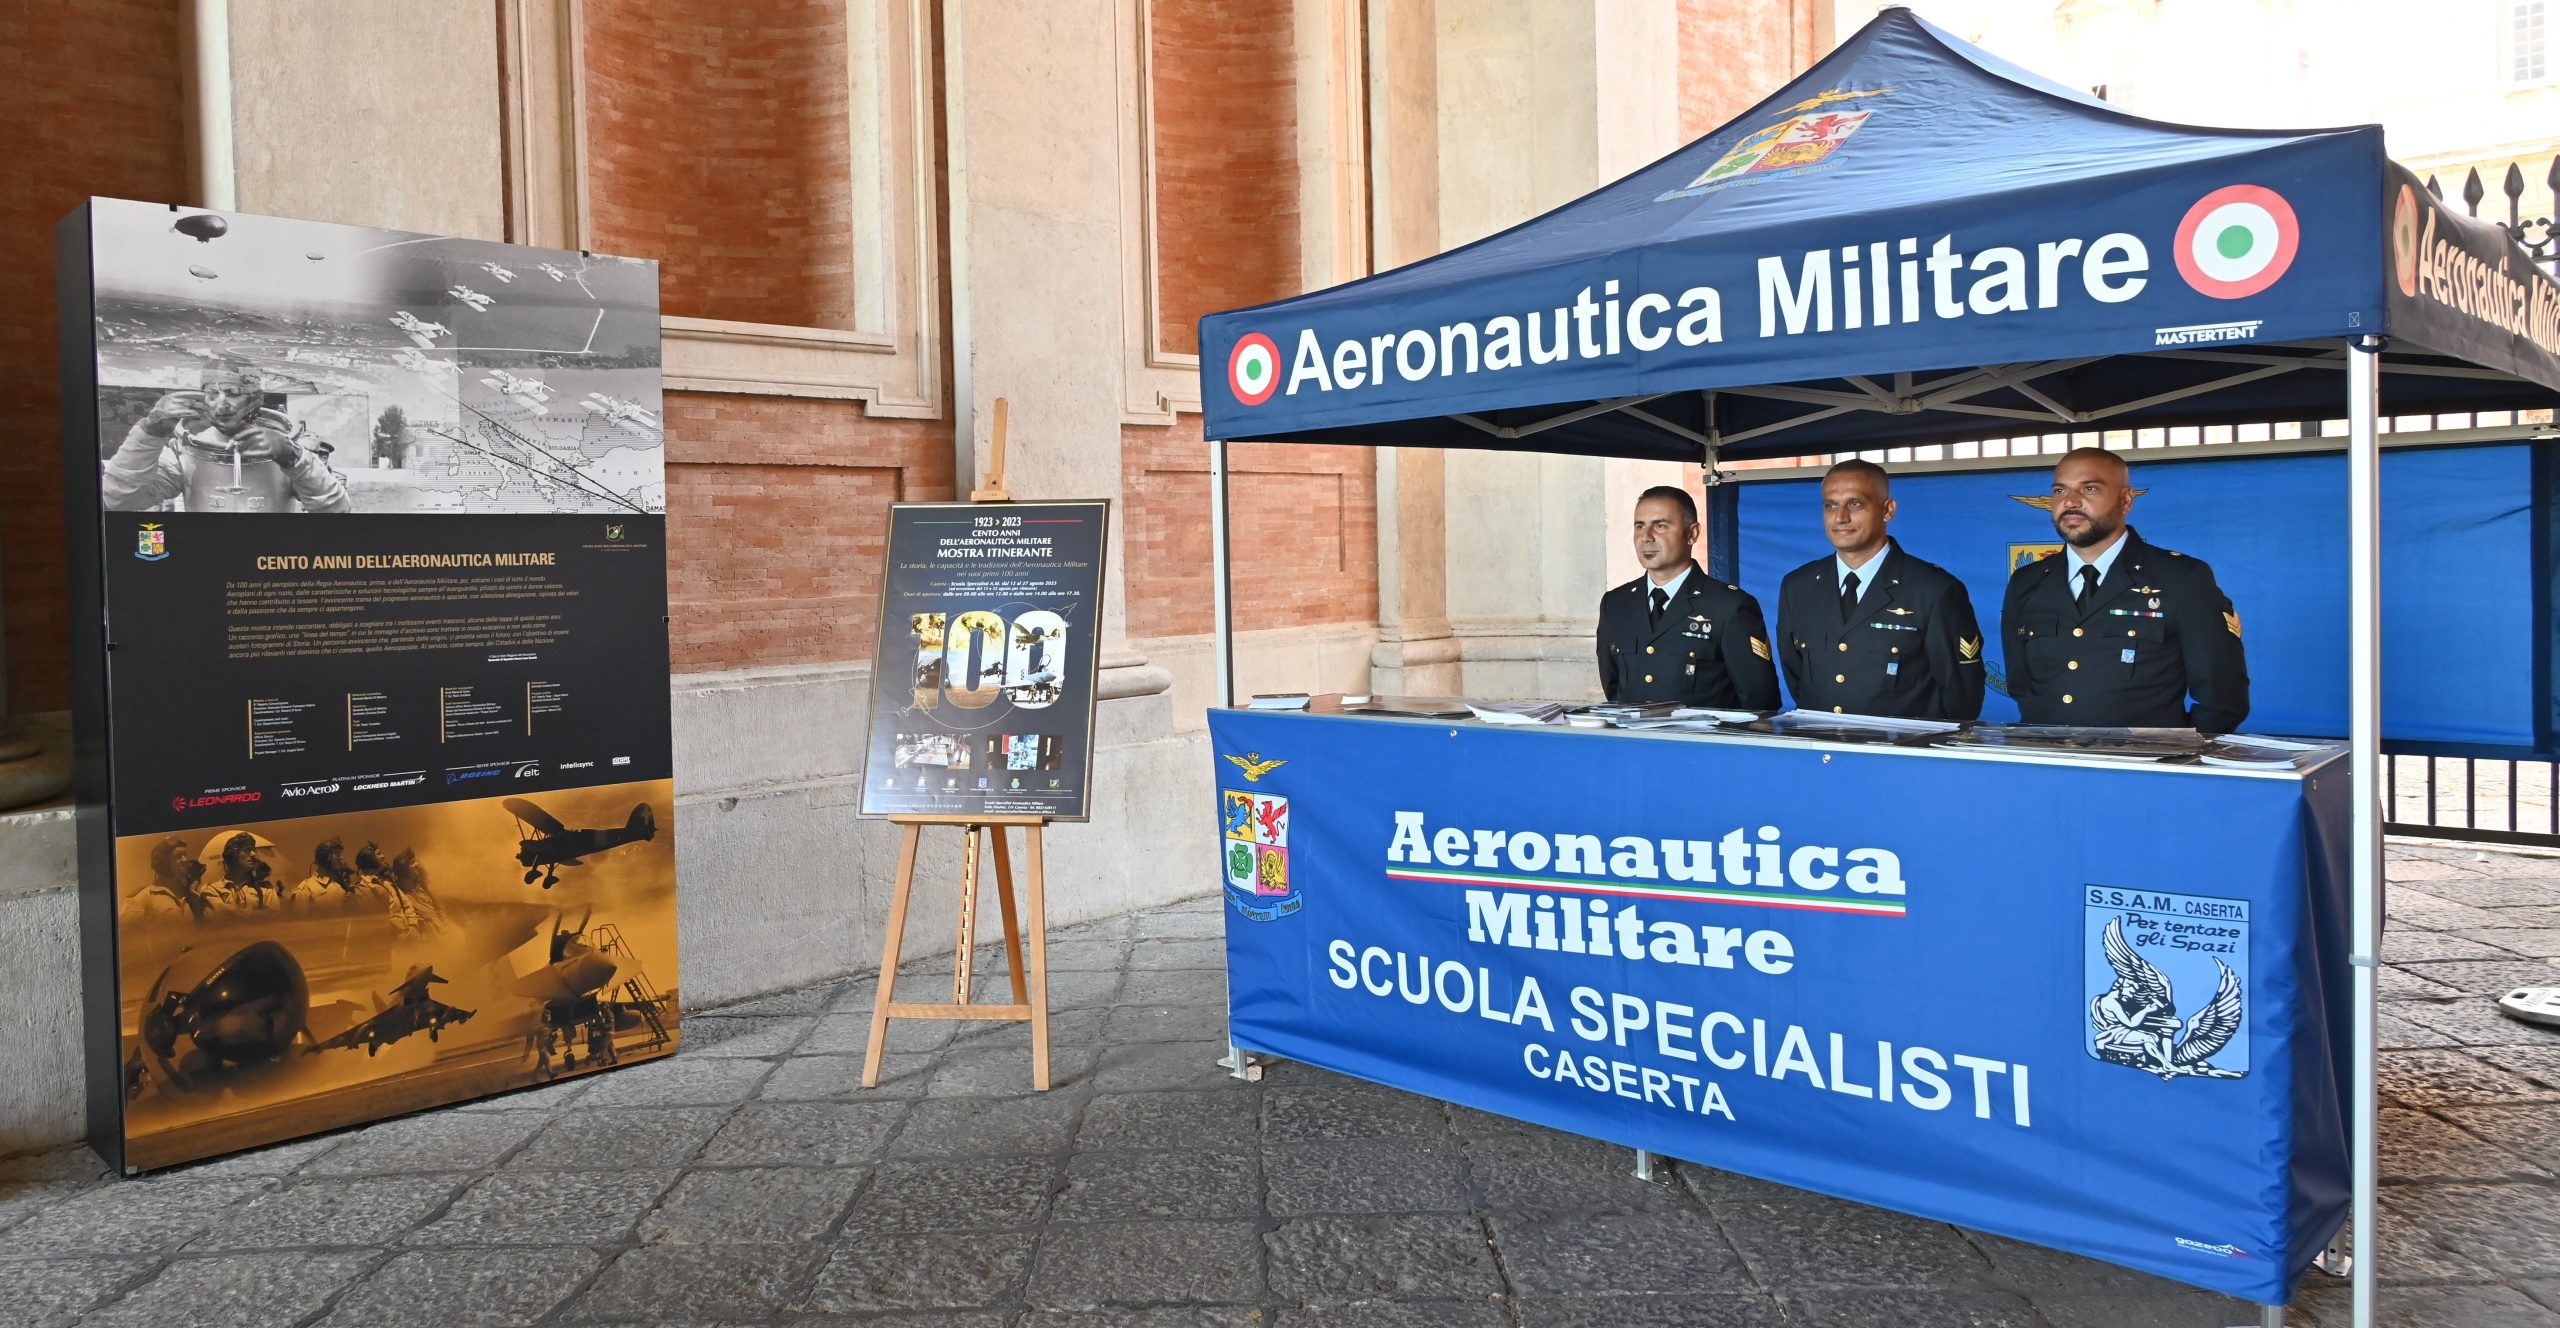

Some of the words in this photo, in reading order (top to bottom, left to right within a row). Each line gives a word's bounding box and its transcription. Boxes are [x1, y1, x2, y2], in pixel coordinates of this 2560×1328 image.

[2419, 206, 2530, 339] Aeronautica
[1286, 280, 1722, 395] Aeronautica
[1758, 233, 2148, 337] Militare
[2155, 326, 2258, 346] MASTERTENT
[974, 517, 993, 527] 1923
[1001, 516, 1021, 527] 2023
[940, 538, 1015, 546] DELL'AERONAUTICA
[1016, 537, 1052, 545] MILITARE
[971, 529, 999, 537] CENTO
[256, 556, 309, 570] CENTO
[312, 555, 351, 570] ANNI
[355, 553, 492, 569] DELL'AERONAUTICA
[495, 552, 556, 566] MILITARE
[936, 548, 984, 558] MOSTRA
[987, 547, 1053, 557] ITINERANTE
[908, 562, 928, 570] storia,
[935, 561, 963, 570] capacità
[910, 610, 1067, 710] 100
[460, 769, 501, 779] BOEING
[281, 786, 305, 797] Avio
[307, 784, 333, 795] Aero
[353, 781, 389, 791] LOCKHEED
[389, 778, 416, 787] MARTIN
[189, 792, 262, 808] LEONARDO
[1386, 812, 1906, 896] Aeronautica
[2090, 889, 2177, 912] S.S.A.M.
[2185, 901, 2243, 919] CASERTA
[1466, 889, 1795, 975] Militare
[2125, 912, 2159, 930] Per
[2164, 920, 2240, 938] tentare
[2136, 932, 2165, 947] gli
[2171, 935, 2236, 954] Spazi
[1329, 940, 1555, 1033] SCUOLA
[1570, 986, 2031, 1127] SPECIALISTI
[1524, 1044, 1736, 1121] CASERTA
[2174, 1236, 2233, 1255] gazebo
